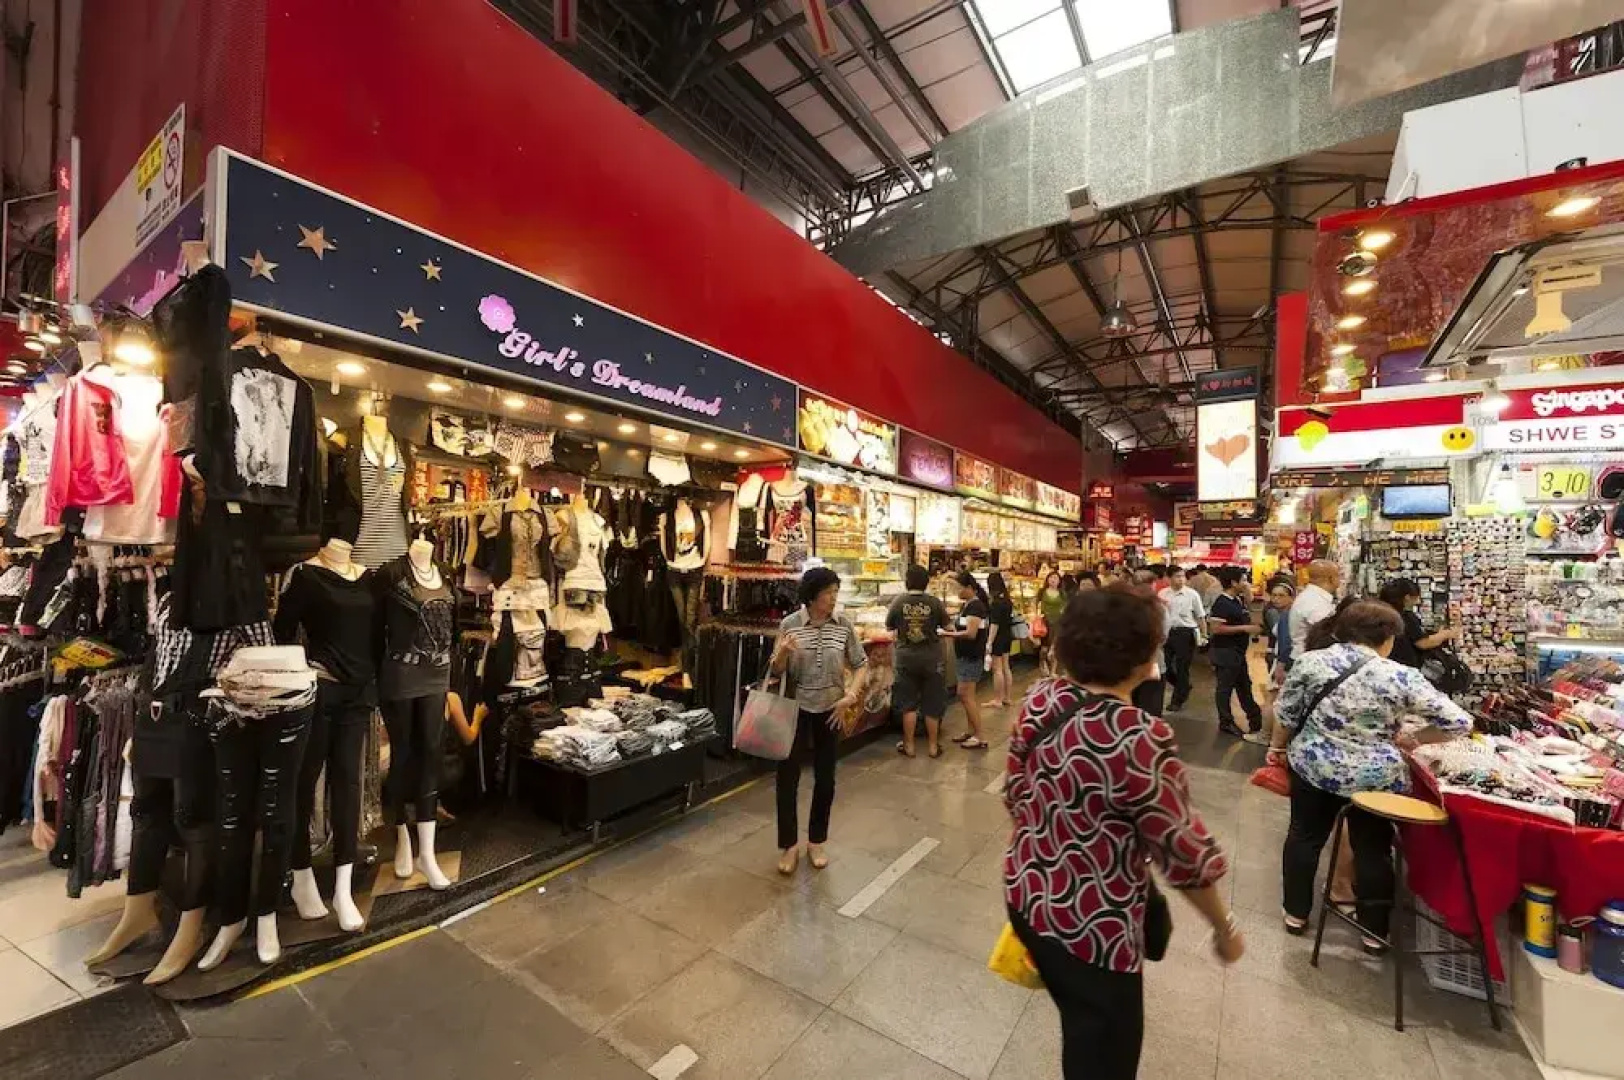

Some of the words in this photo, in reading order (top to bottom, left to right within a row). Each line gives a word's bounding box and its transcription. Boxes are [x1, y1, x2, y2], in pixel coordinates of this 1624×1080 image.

[498, 327, 586, 378] Girl's
[590, 359, 722, 417] Dreamland
[1509, 425, 1588, 443] SHWE
